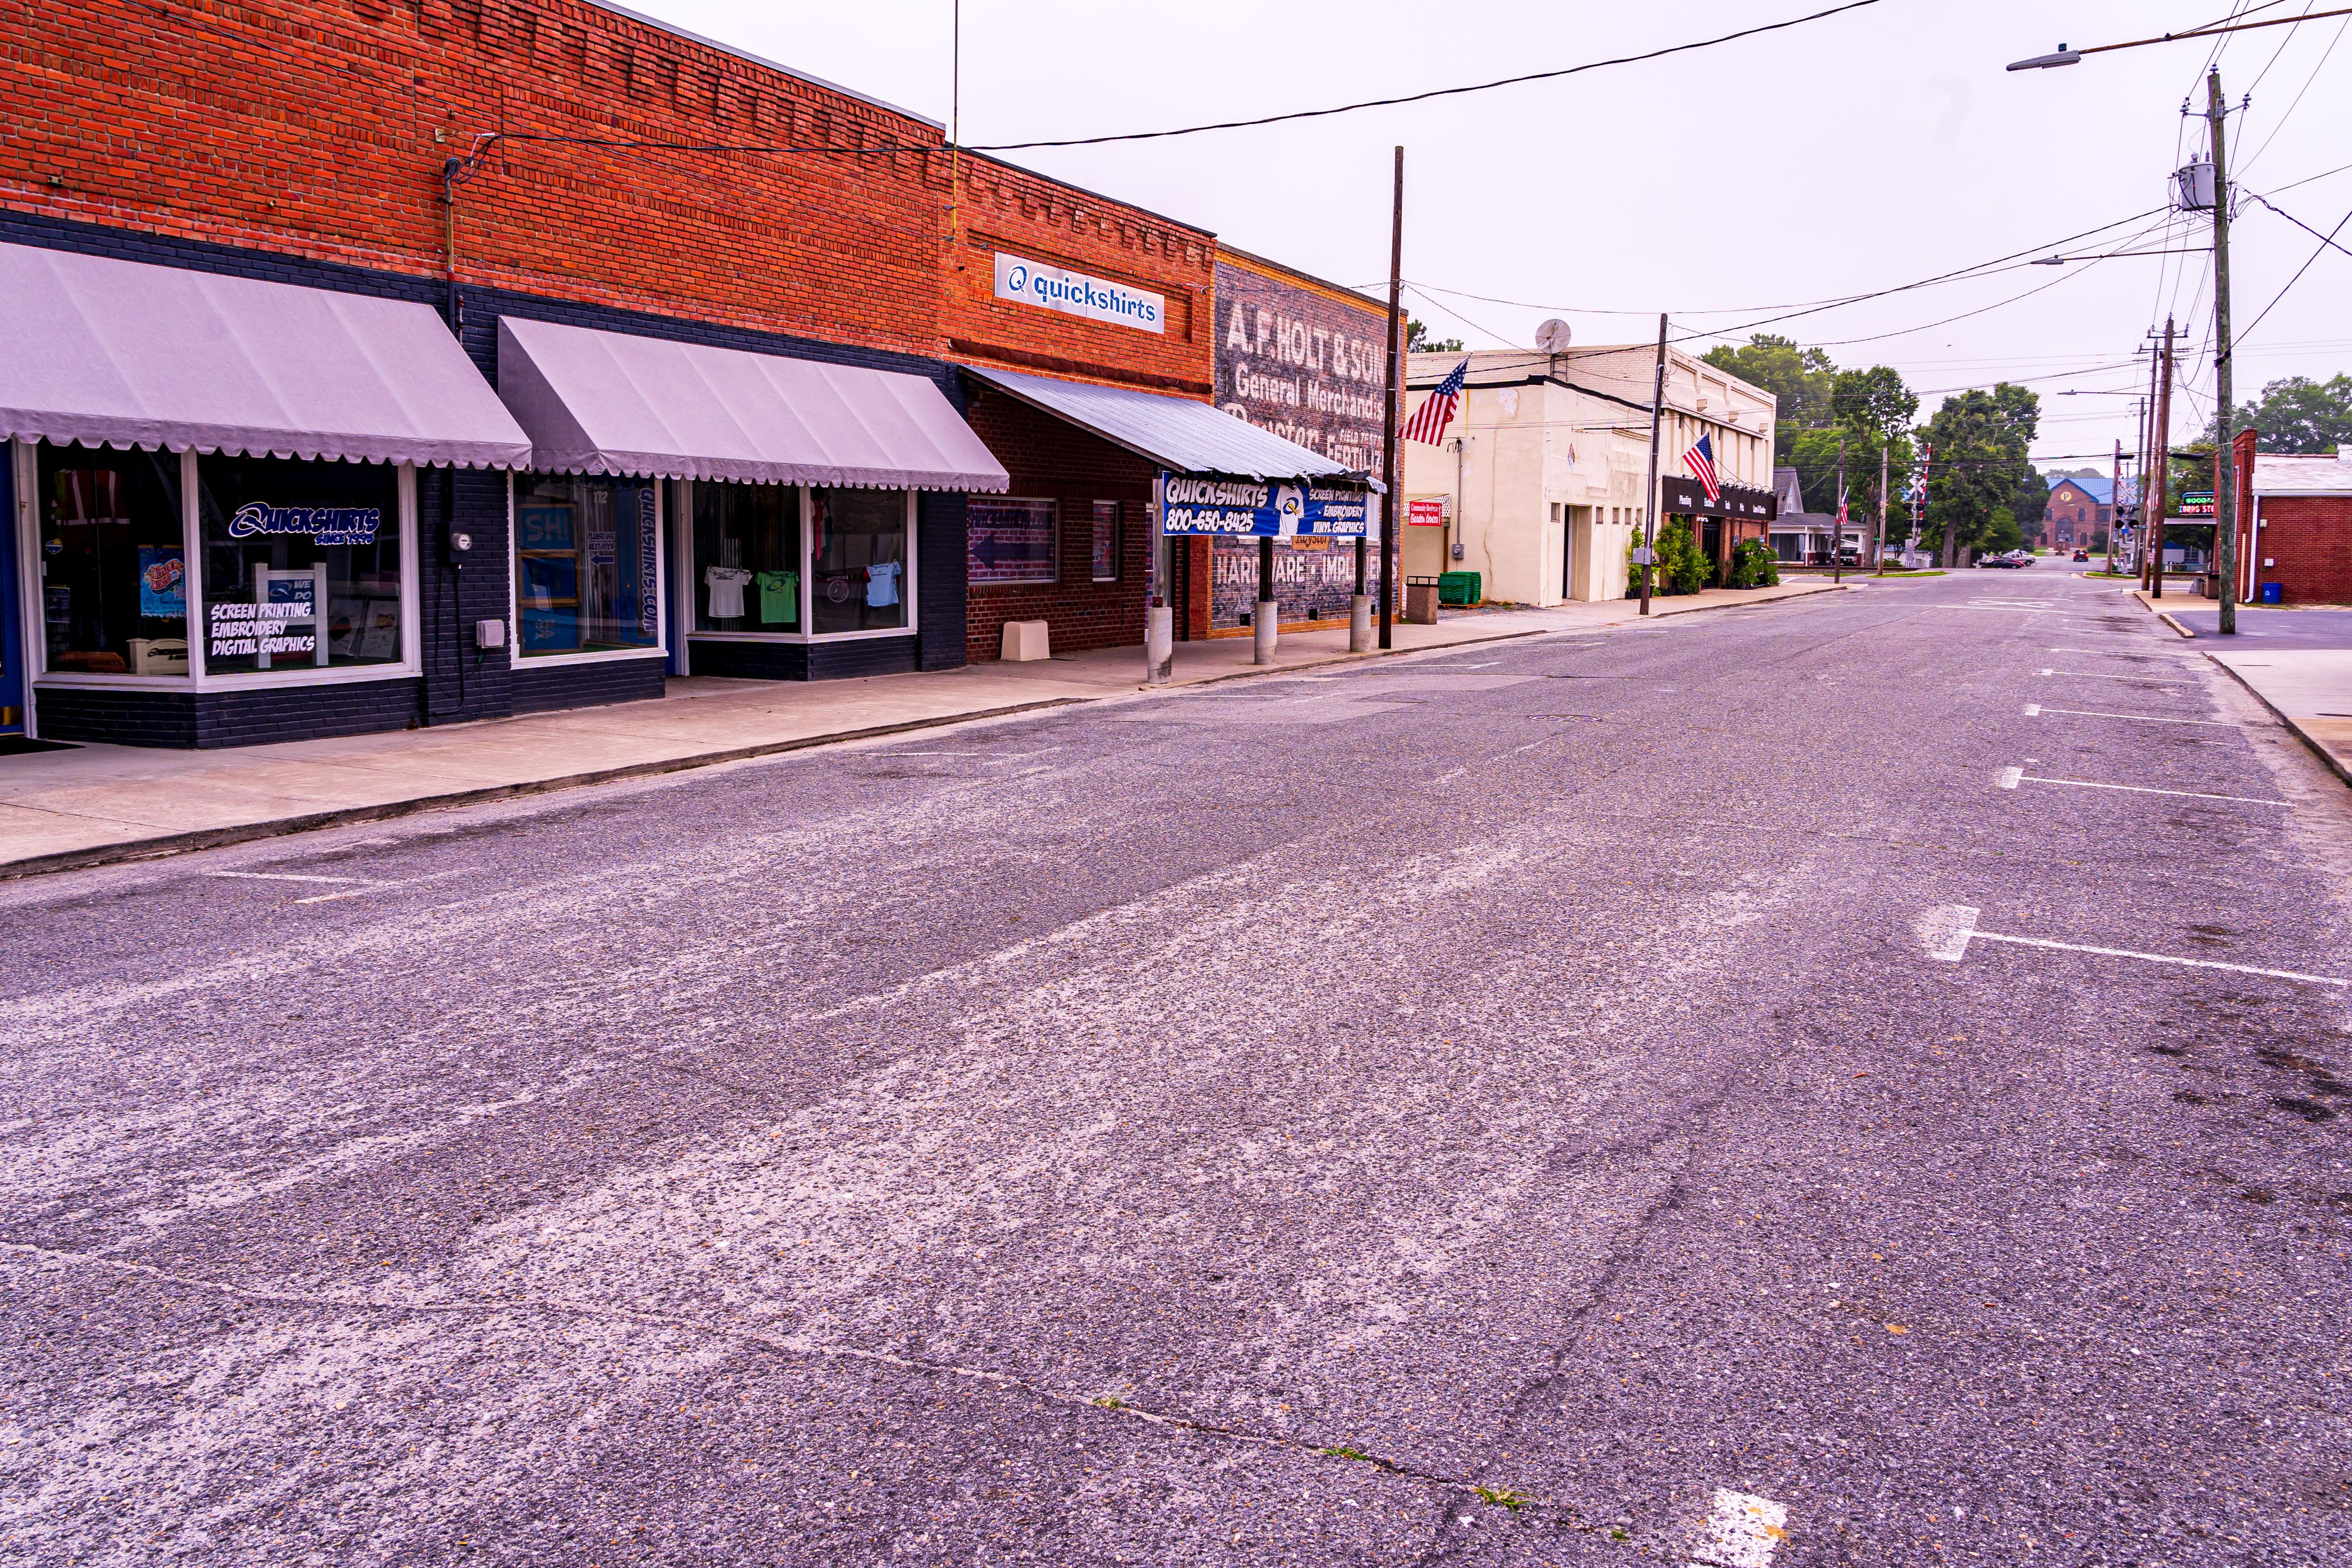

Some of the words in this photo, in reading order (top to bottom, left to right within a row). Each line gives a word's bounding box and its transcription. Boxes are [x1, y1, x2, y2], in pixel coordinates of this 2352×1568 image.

[1034, 277, 1155, 322] quickshirts
[1333, 334, 1348, 376] &
[1235, 362, 1301, 407] General
[1307, 377, 1385, 422] Merchandis
[1340, 429, 1358, 444] FIELD
[1166, 477, 1268, 507] QUICKSHIRTS
[1309, 488, 1334, 502] SCREEN
[1335, 491, 1364, 503] PRINTING
[2118, 484, 2137, 501] CROSSING
[229, 502, 380, 537] QUICKSHIRTS
[1324, 505, 1364, 517] EMBROIDERY
[1410, 513, 1425, 524] Garden
[1425, 514, 1438, 524] Center
[1166, 509, 1254, 532] 800-650-8425
[1313, 521, 1331, 533] VINYL
[1332, 521, 1364, 534] GRAPHICS
[315, 533, 345, 545] SINCE
[346, 533, 374, 544] 1995
[588, 531, 604, 541] PLEASE
[605, 531, 615, 540] USE
[588, 542, 601, 551] NEXT
[602, 542, 615, 551] DOOR
[151, 560, 179, 579] WONDER
[1217, 556, 1305, 584] HARDARE
[151, 573, 172, 589] WORLD
[293, 580, 312, 589] WE
[295, 591, 312, 600] DO
[211, 603, 257, 620] SCREEN
[258, 601, 311, 618] PRINTING
[211, 620, 288, 638] EMBROIDERY
[212, 638, 258, 656] DIGITAL
[259, 636, 315, 654] GRAPHICS
